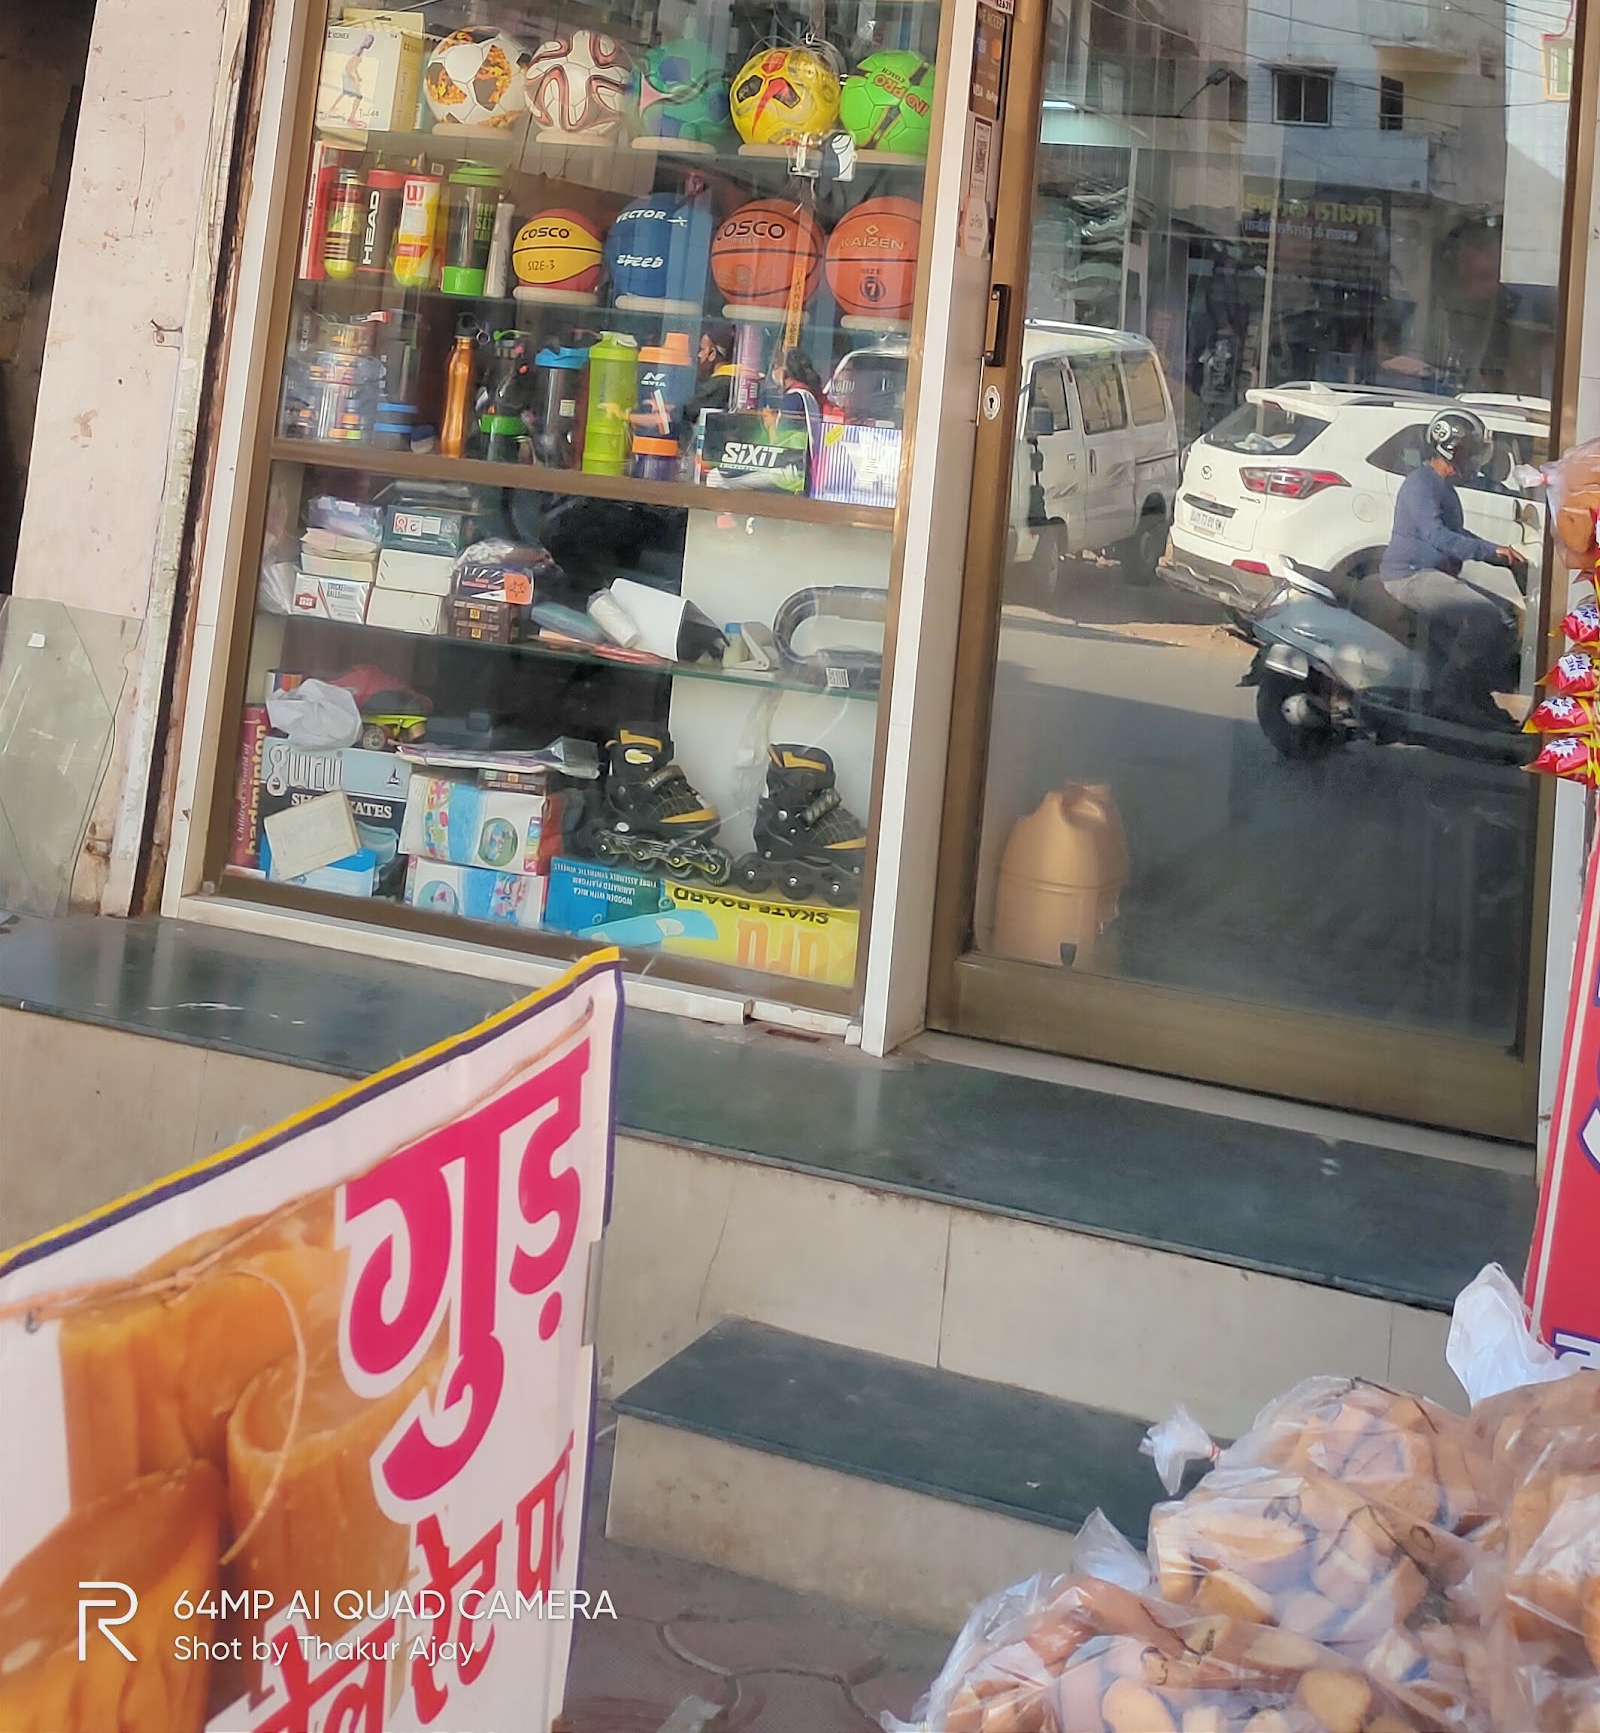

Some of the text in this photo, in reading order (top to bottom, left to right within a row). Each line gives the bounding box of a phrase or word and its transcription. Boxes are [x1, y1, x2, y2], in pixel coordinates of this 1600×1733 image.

[873, 73, 908, 100] PRO
[362, 189, 380, 265] HEAD
[616, 209, 667, 224] VECTOR
[521, 227, 570, 241] COSCO
[840, 237, 905, 251] KAIZEN
[242, 741, 252, 755] of
[240, 756, 251, 786] world
[266, 743, 344, 797] guru
[245, 723, 267, 856] badminton
[573, 886, 633, 906] WOODEN WITH MICA
[673, 886, 830, 925] SKATE BOARD
[345, 1035, 591, 1501] गुड़
